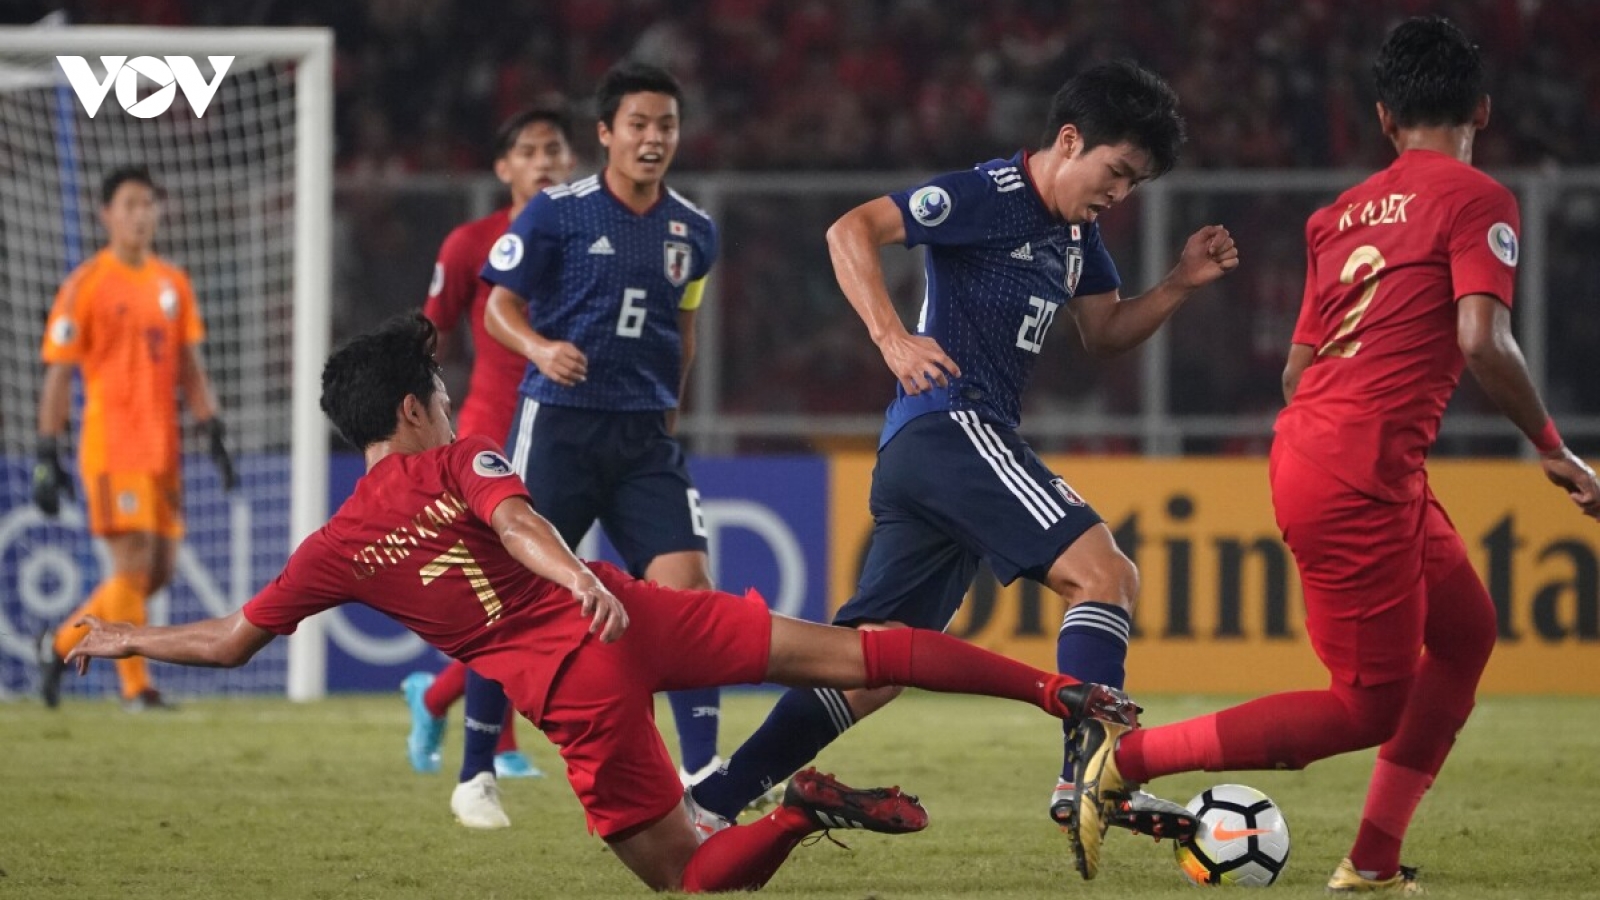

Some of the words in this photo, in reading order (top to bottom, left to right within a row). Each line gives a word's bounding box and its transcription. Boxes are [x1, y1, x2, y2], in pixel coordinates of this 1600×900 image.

[616, 287, 647, 338] 6
[1016, 295, 1059, 354] 20
[1318, 245, 1386, 358] 2
[419, 538, 502, 627] 7
